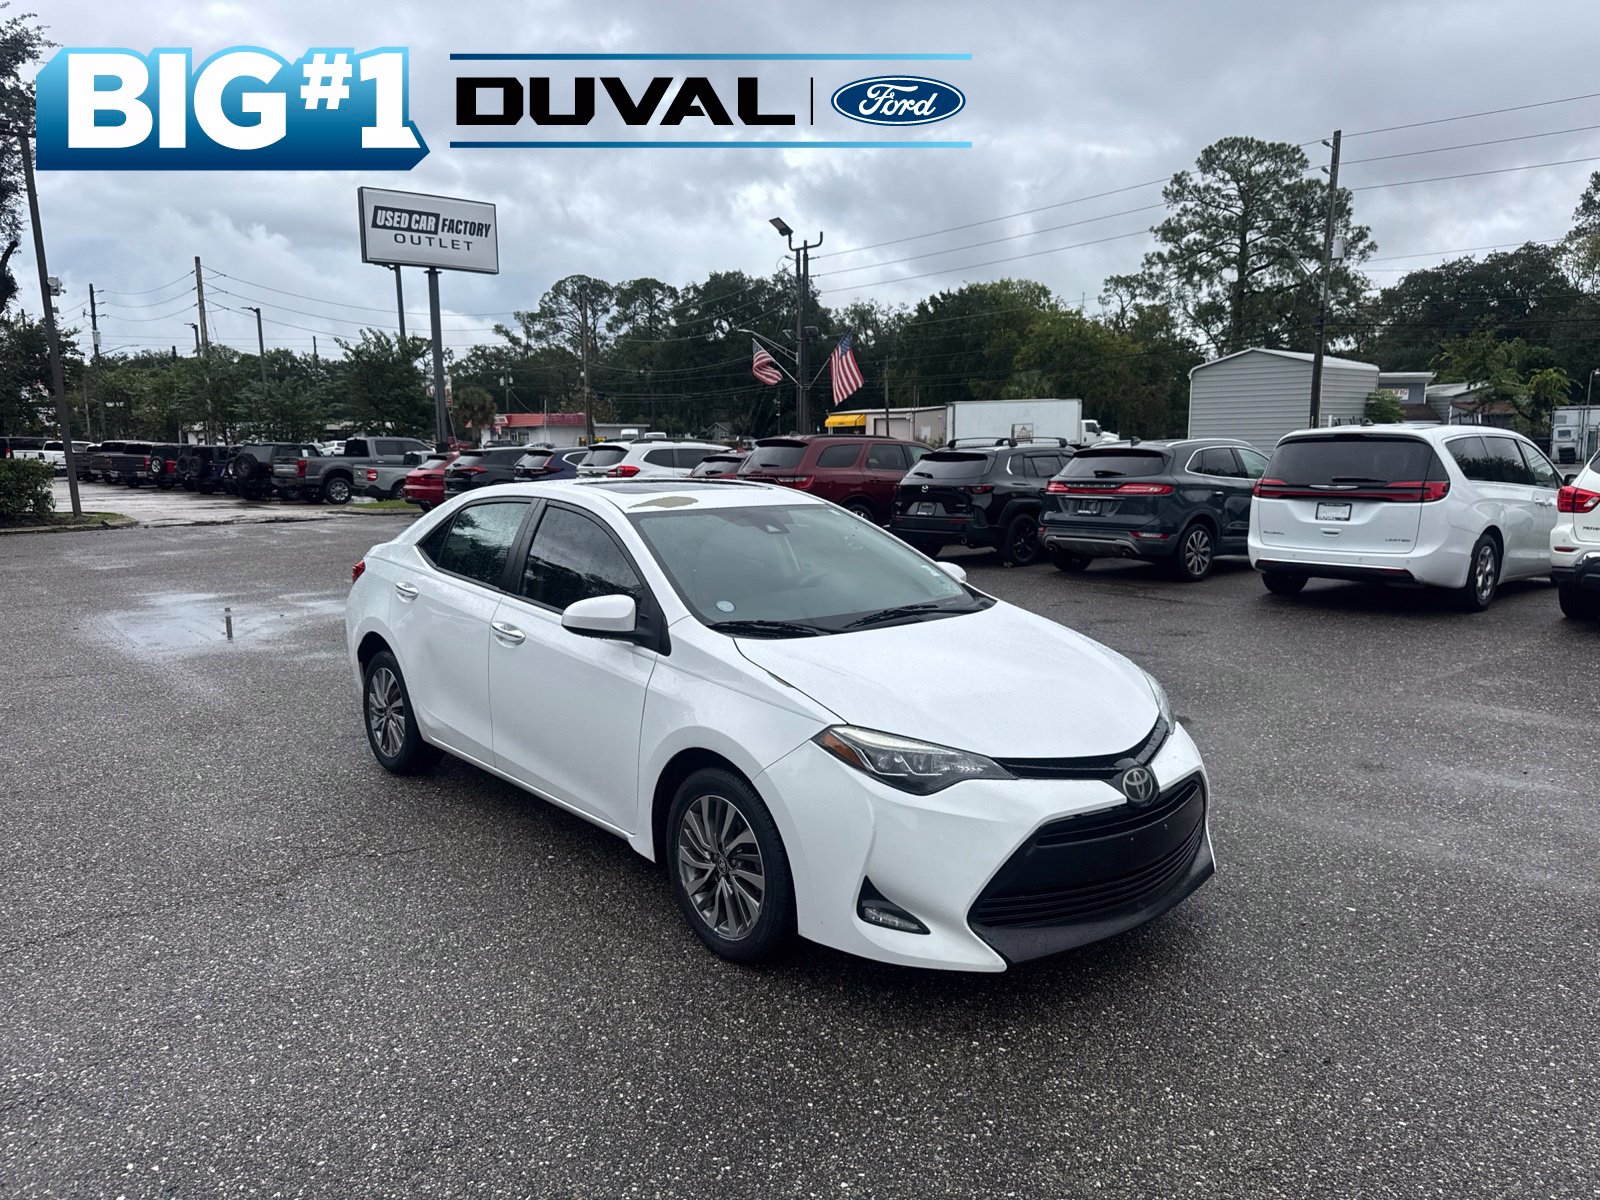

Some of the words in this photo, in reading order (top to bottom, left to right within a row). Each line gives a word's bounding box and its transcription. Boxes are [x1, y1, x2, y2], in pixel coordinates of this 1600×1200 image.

[376, 209, 409, 228] USED
[410, 213, 437, 232] CAR
[441, 217, 491, 238] FACTORY
[394, 233, 473, 251] OUTLET
